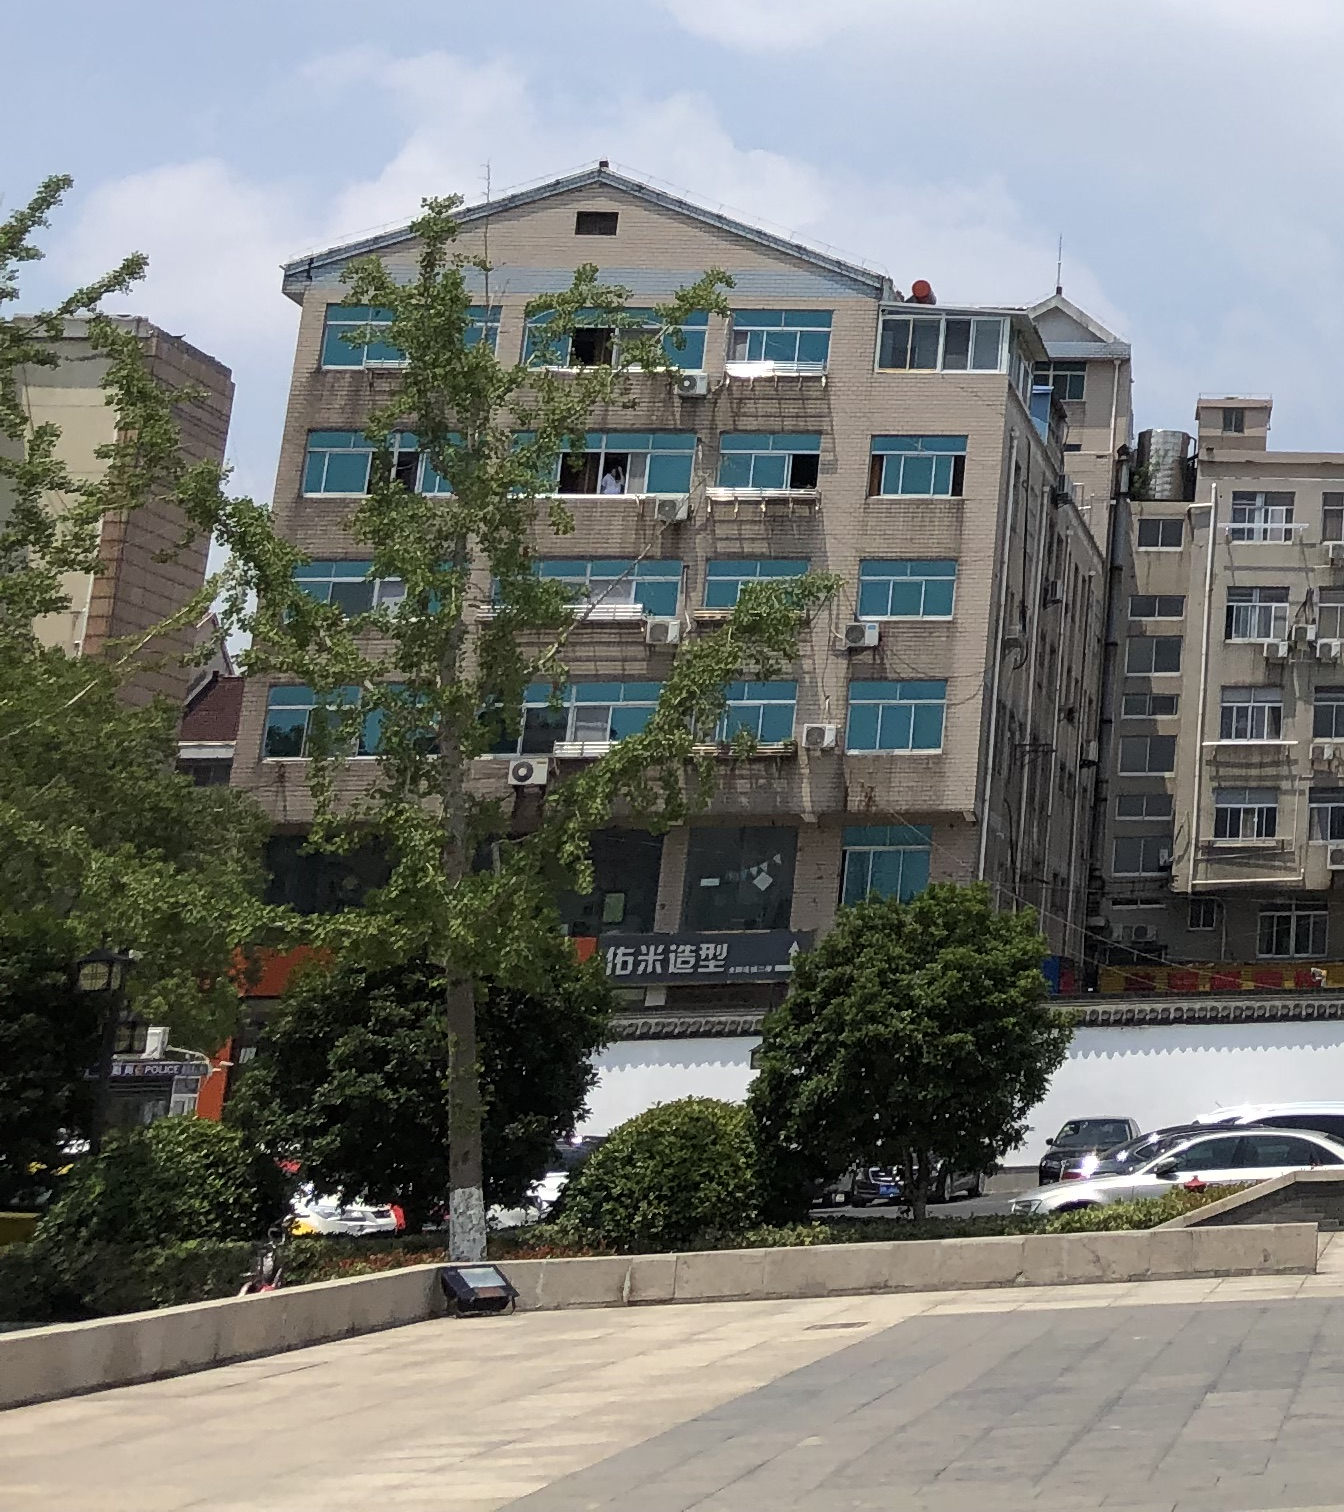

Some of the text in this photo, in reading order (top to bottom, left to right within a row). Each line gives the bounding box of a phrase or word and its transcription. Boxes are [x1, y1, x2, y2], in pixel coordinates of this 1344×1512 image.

[605, 942, 729, 976] 佑米造型
[144, 1064, 180, 1075] POLICE
